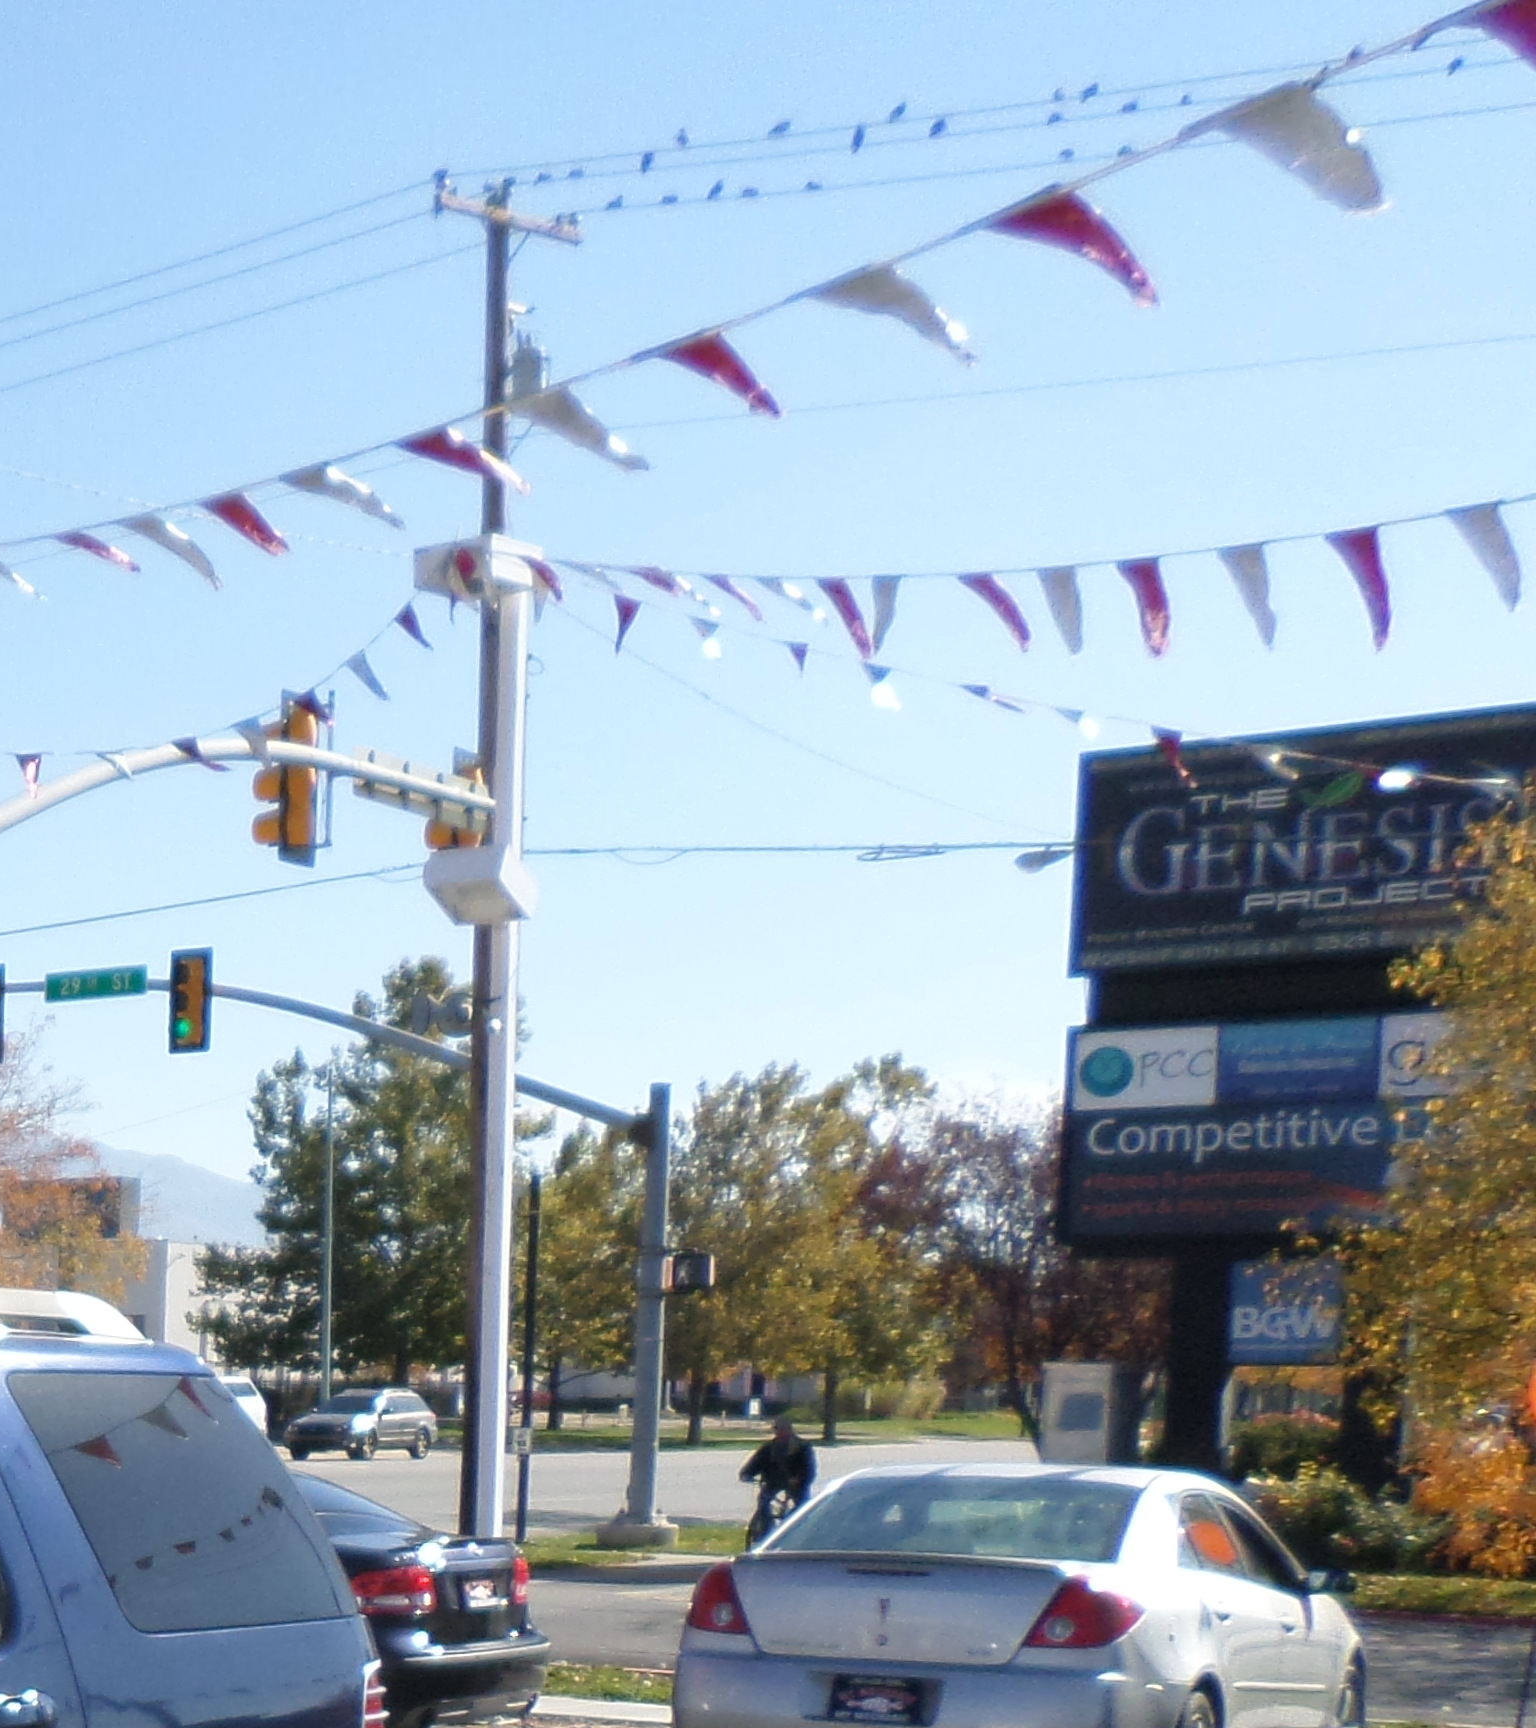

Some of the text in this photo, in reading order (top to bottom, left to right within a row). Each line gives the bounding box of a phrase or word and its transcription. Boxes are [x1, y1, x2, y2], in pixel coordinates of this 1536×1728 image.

[1190, 789, 1288, 815] THE
[1243, 876, 1490, 914] PROJECT
[112, 972, 133, 991] ST
[1140, 1049, 1214, 1088] PCC
[1087, 1109, 1379, 1163] Competitive
